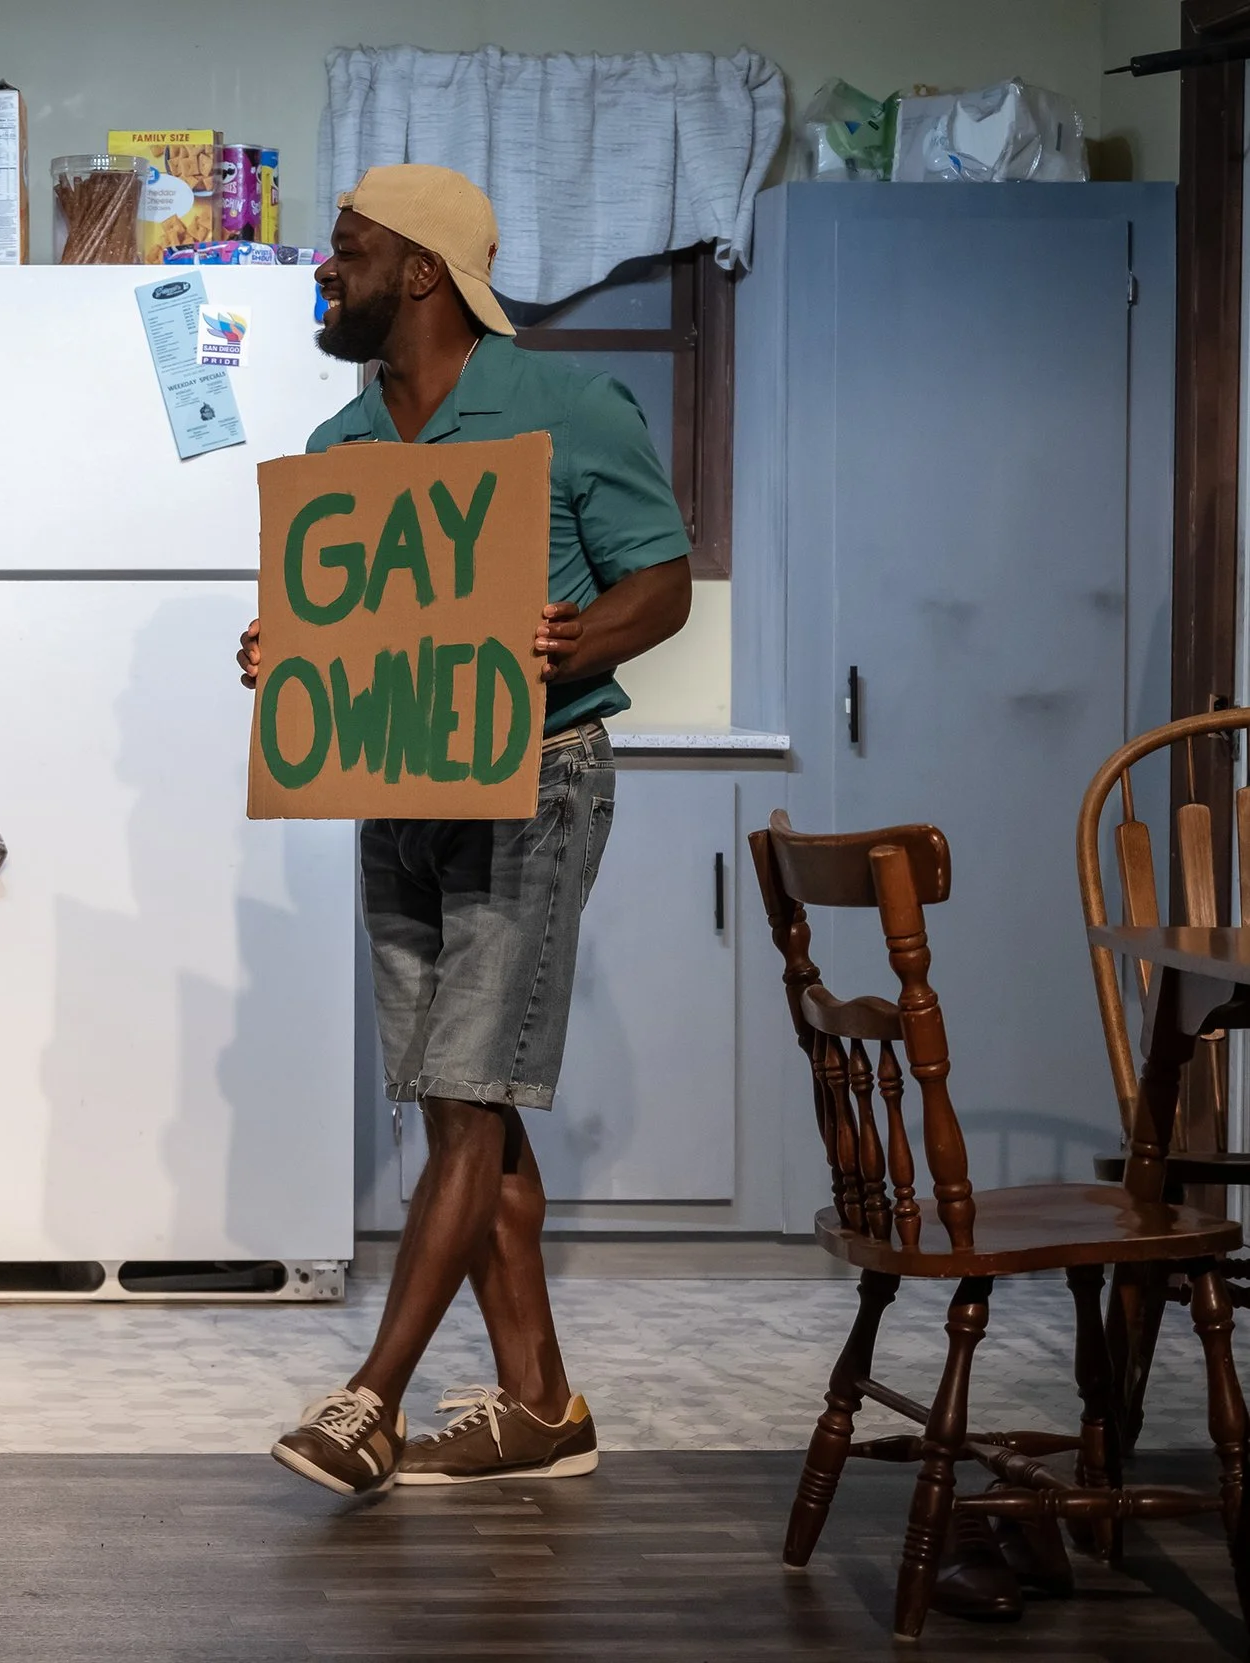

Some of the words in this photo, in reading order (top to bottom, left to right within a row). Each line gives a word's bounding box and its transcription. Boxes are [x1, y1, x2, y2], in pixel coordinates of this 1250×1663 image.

[132, 134, 167, 142] FAMILY
[170, 133, 190, 142] SIZE
[147, 189, 176, 197] heddar
[203, 344, 218, 352] SAN
[219, 345, 240, 353] DIEGO
[203, 357, 238, 366] PRIDE
[167, 378, 197, 392] WEEKDAY
[199, 371, 227, 383] SPECIALS
[283, 471, 498, 626] GAY
[260, 635, 531, 790] OWNED
